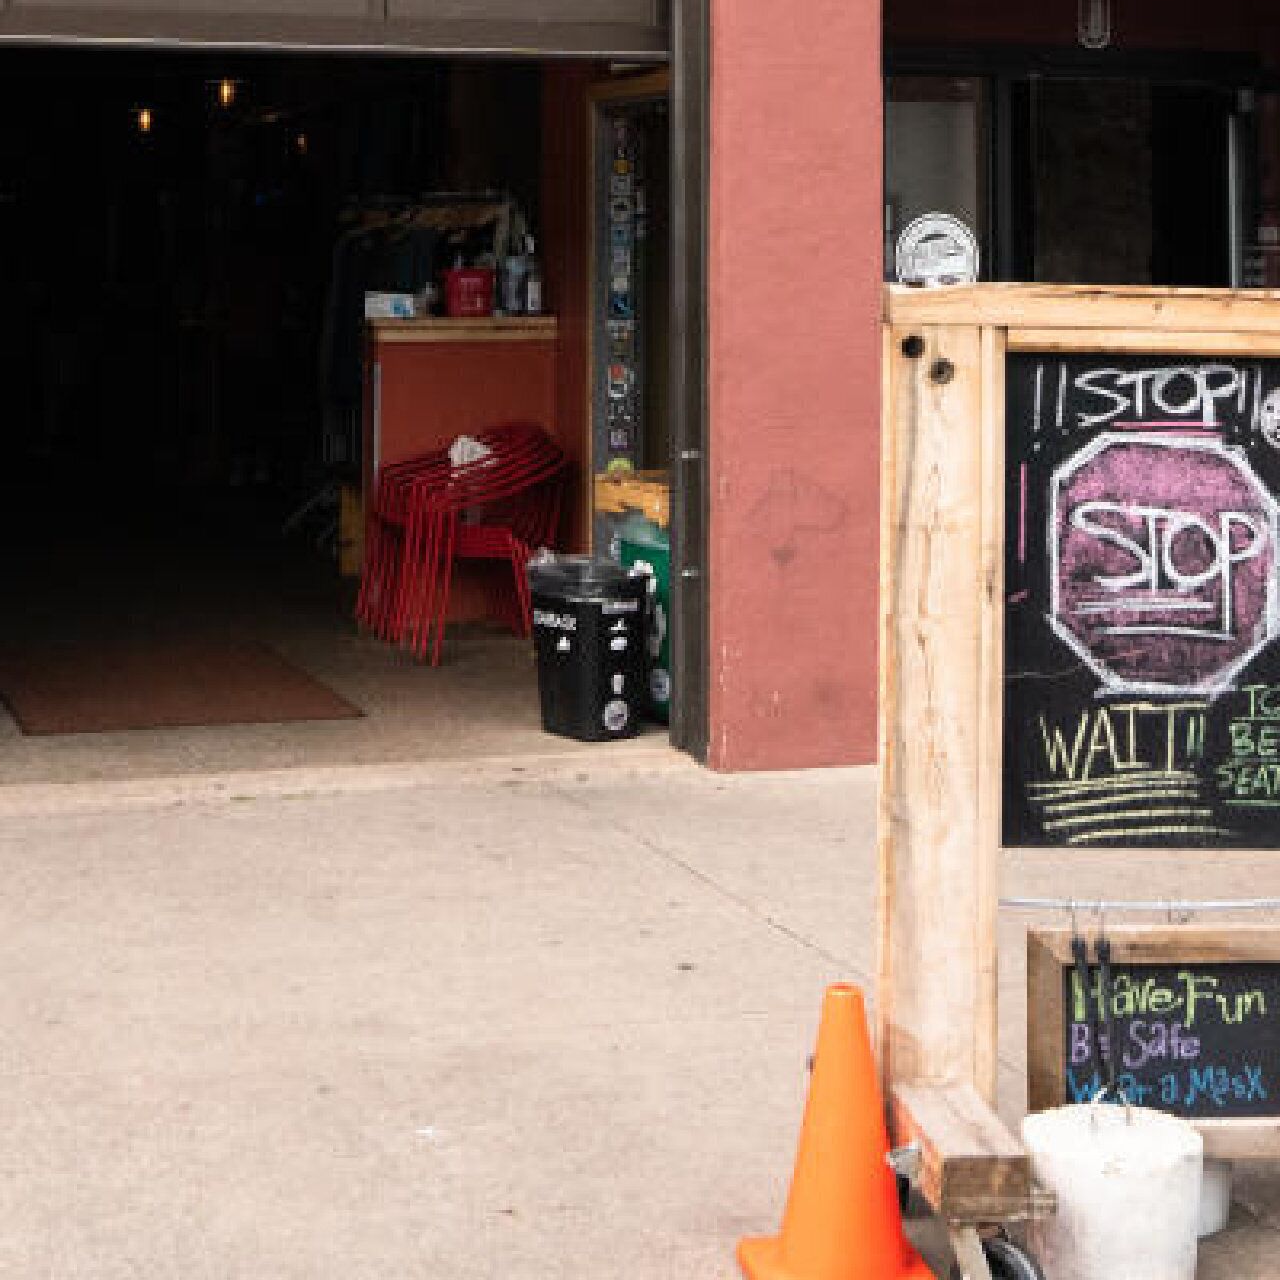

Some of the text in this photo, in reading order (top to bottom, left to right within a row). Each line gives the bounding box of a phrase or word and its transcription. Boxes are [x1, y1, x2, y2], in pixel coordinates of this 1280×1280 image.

[1071, 501, 1267, 637] STOP
[1228, 722, 1280, 757] BE
[1177, 971, 1268, 1028] Fun
[1065, 1067, 1152, 1105] War
